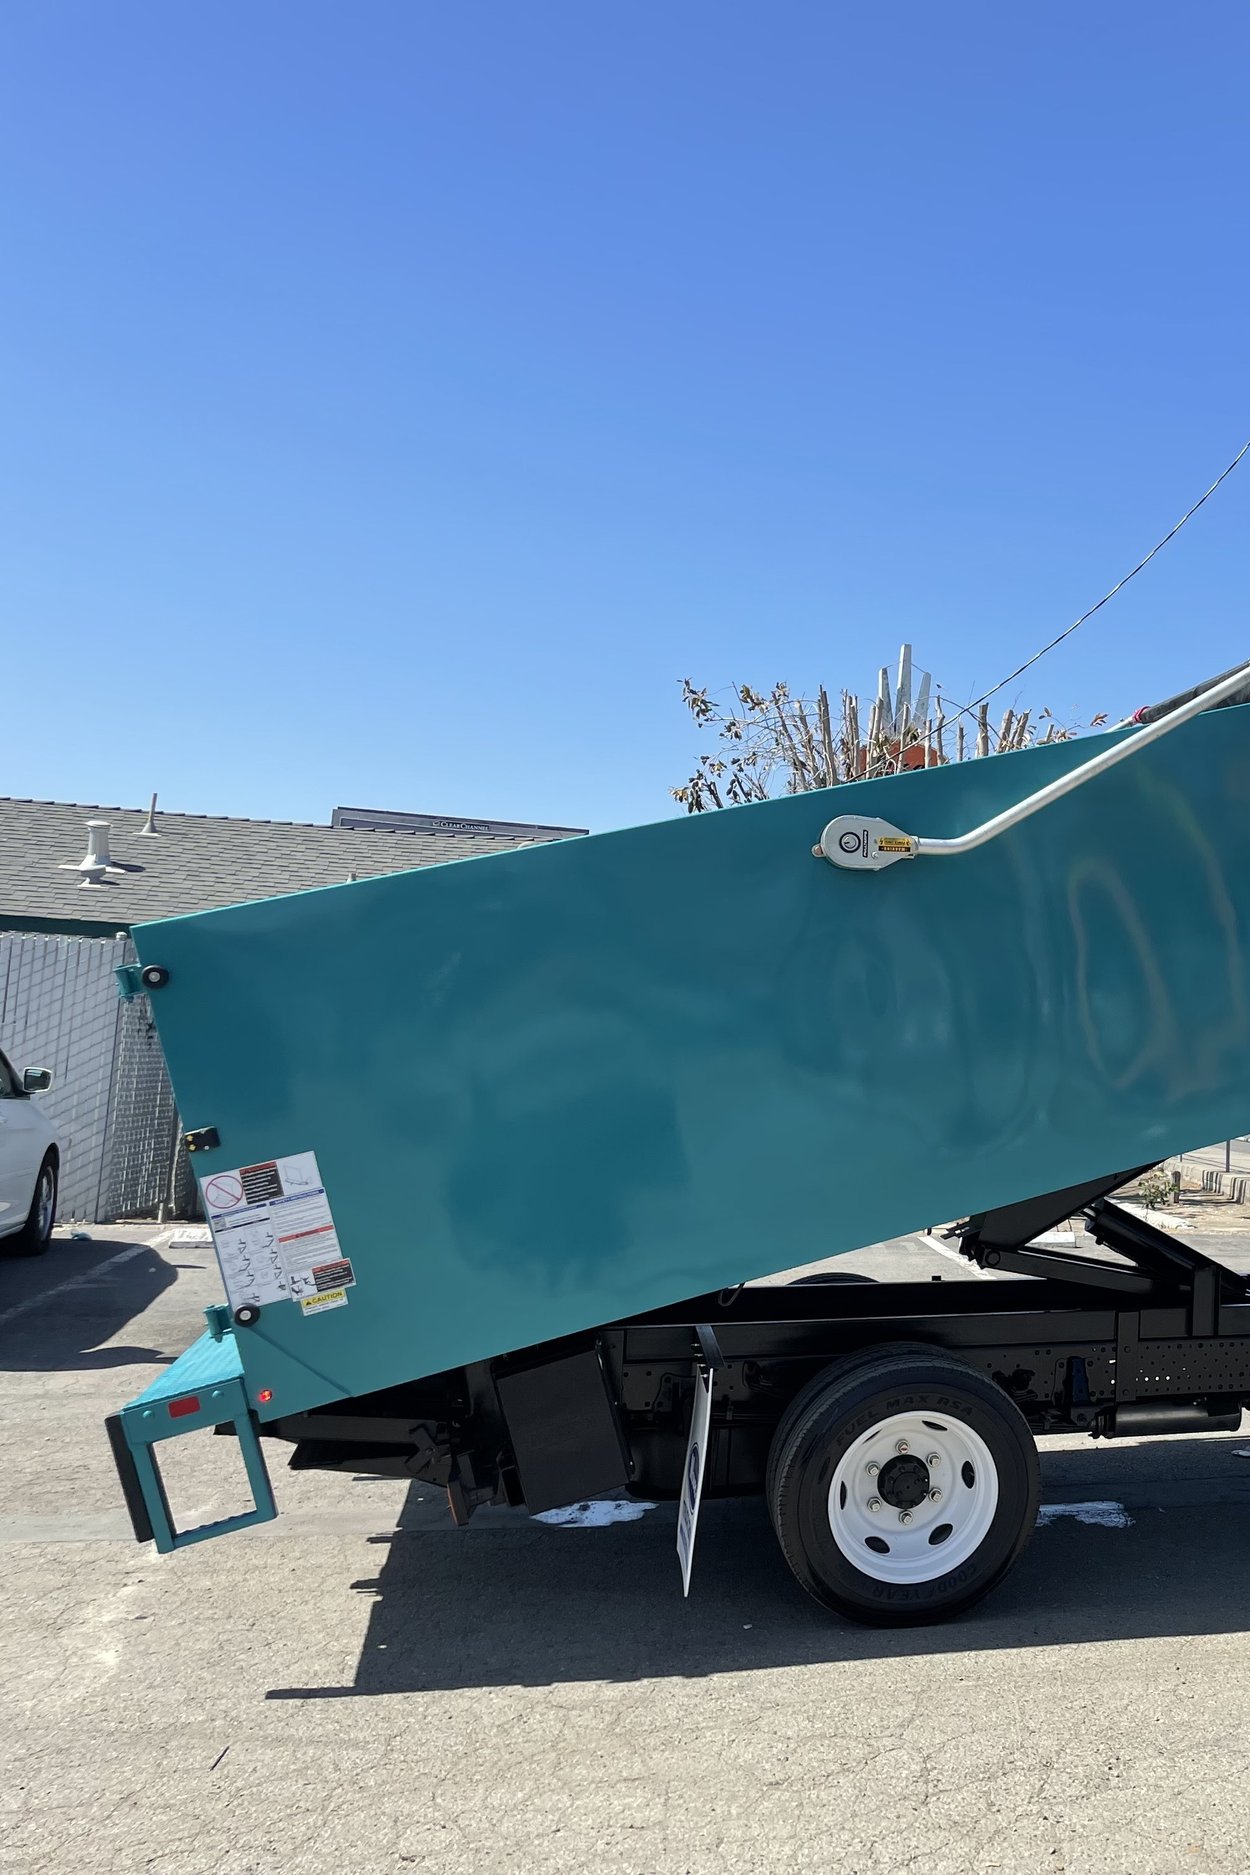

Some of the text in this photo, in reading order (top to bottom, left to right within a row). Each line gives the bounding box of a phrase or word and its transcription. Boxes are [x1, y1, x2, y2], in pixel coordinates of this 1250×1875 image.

[312, 1292, 342, 1304] CAUTION
[835, 1395, 974, 1446] FUEL MAX RSA
